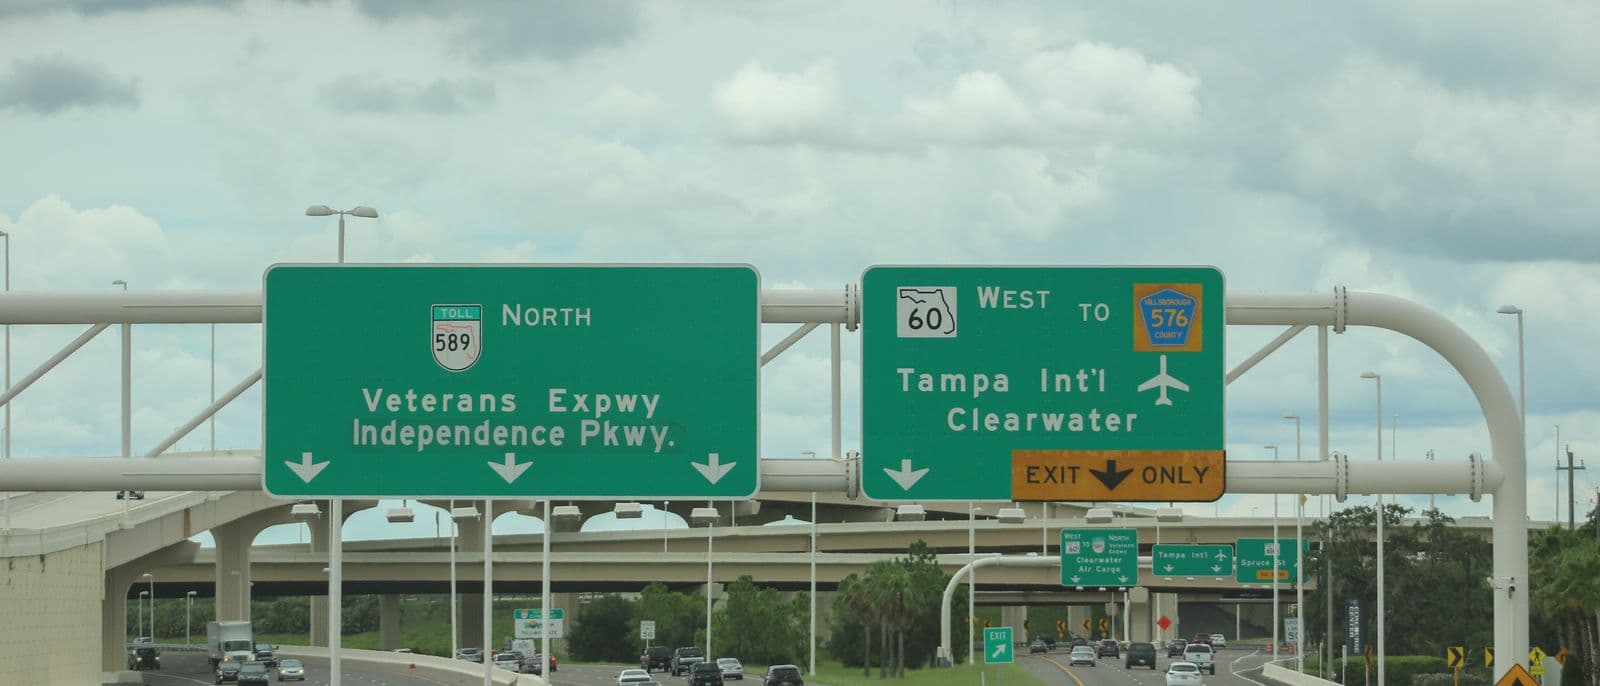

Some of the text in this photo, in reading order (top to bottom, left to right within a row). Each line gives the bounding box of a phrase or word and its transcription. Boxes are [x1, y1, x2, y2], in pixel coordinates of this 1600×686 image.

[977, 286, 1110, 322] WEST TO
[1145, 298, 1191, 306] HILLSBOROUGH
[440, 307, 474, 320] TOLL
[502, 303, 591, 327] NORTH
[908, 308, 943, 330] 60
[1151, 308, 1189, 328] 576
[435, 333, 471, 352] 589
[1154, 331, 1183, 339] COUNTY
[897, 368, 1105, 398] Tampa Int'l
[362, 388, 661, 420] Veterans Expwy
[947, 407, 1138, 432] Clearwater
[353, 418, 675, 453] Independence Pkwy.
[1026, 466, 1209, 484] EXIT ONLY
[1158, 551, 1208, 559] Tampa Int'l
[1241, 559, 1286, 568] Spruce St
[1096, 566, 1121, 574] Cargo
[990, 631, 1007, 641] EXIT
